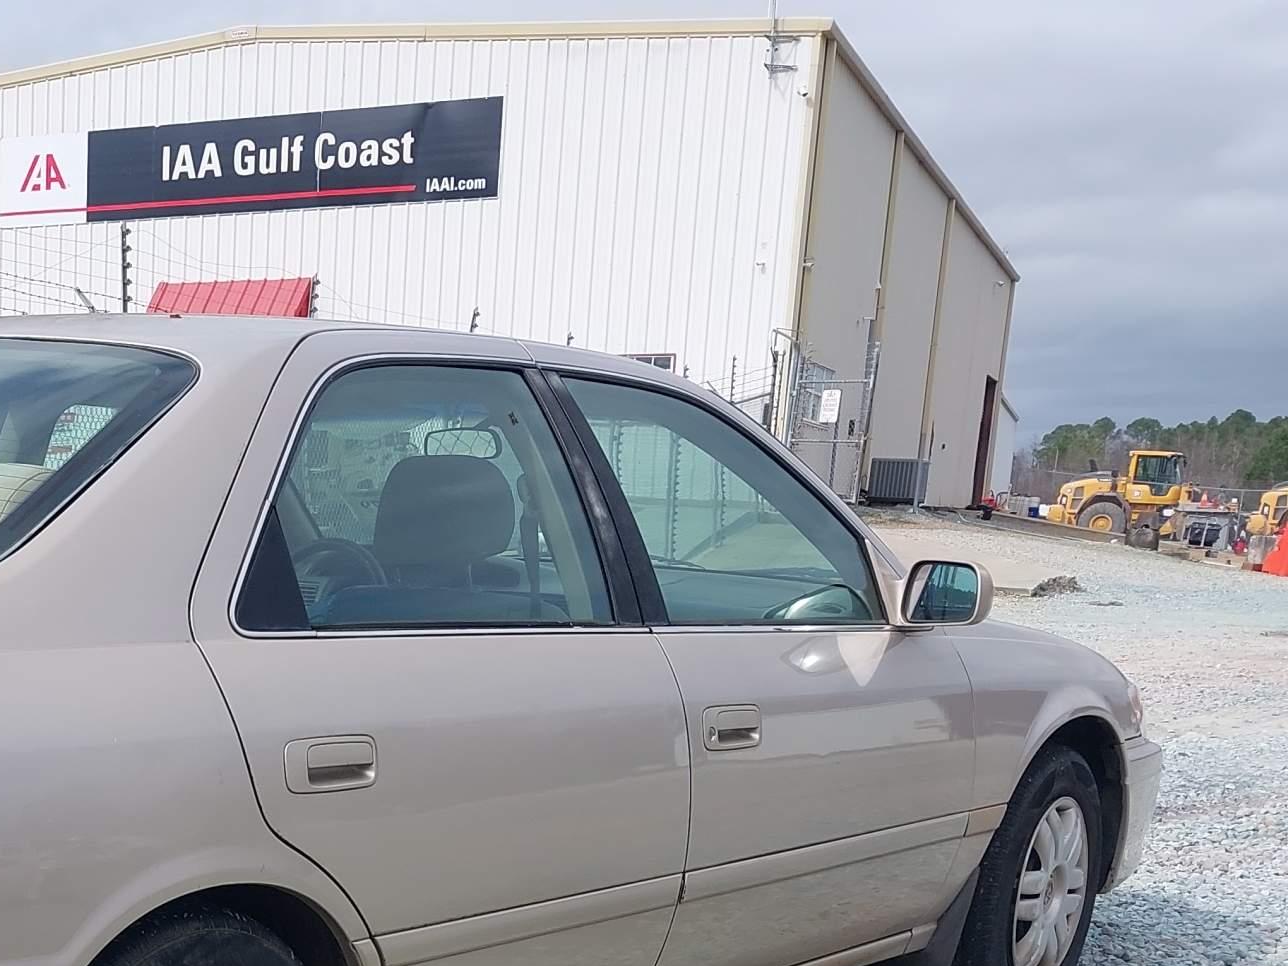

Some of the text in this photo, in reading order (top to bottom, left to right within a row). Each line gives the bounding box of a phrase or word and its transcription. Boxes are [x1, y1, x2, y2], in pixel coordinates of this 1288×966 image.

[162, 131, 415, 181] IAA Gulf Coast
[425, 176, 486, 193] IAAI.com
